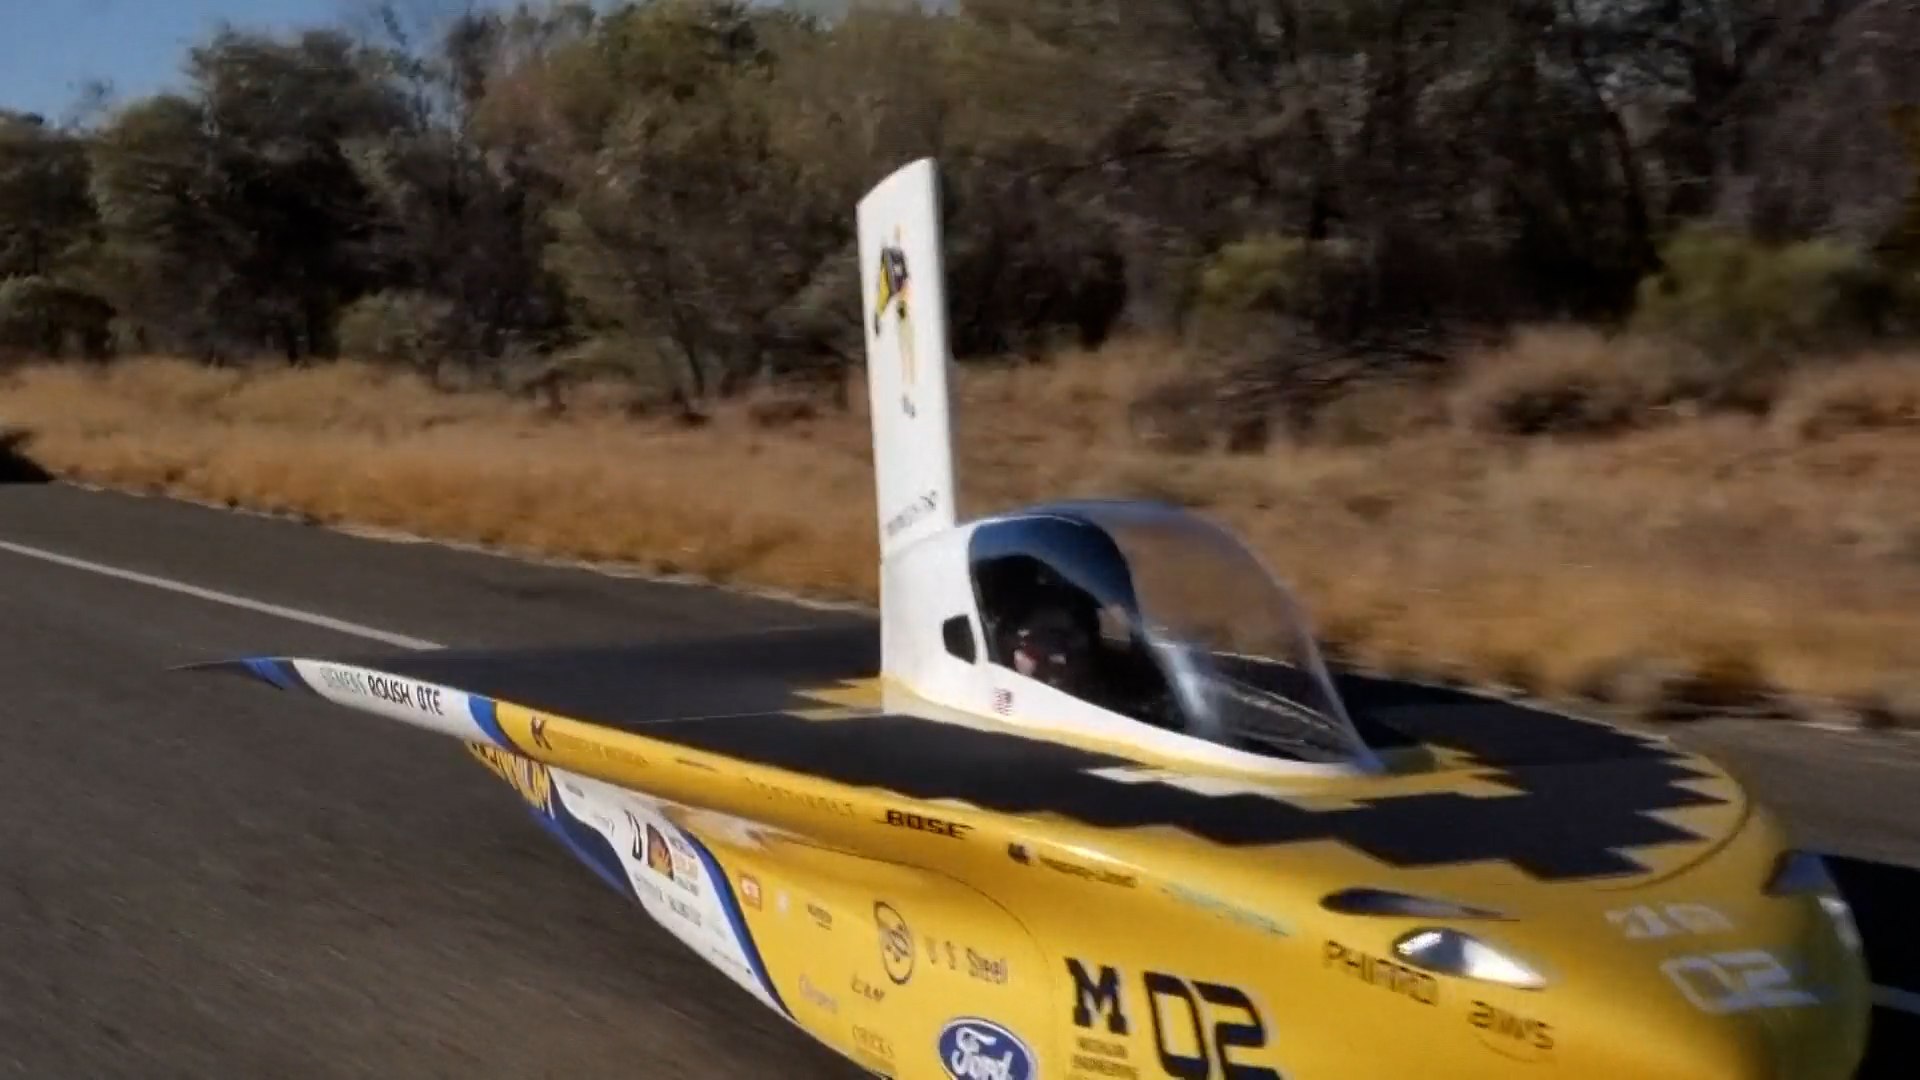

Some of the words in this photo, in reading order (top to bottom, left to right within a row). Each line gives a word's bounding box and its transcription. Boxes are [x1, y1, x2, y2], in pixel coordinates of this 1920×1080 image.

[367, 674, 413, 708] ROUSH
[874, 809, 975, 840] BOSE
[1064, 956, 1129, 1035] M
[1143, 970, 1284, 1080] 02
[951, 1026, 1013, 1080] Ford
